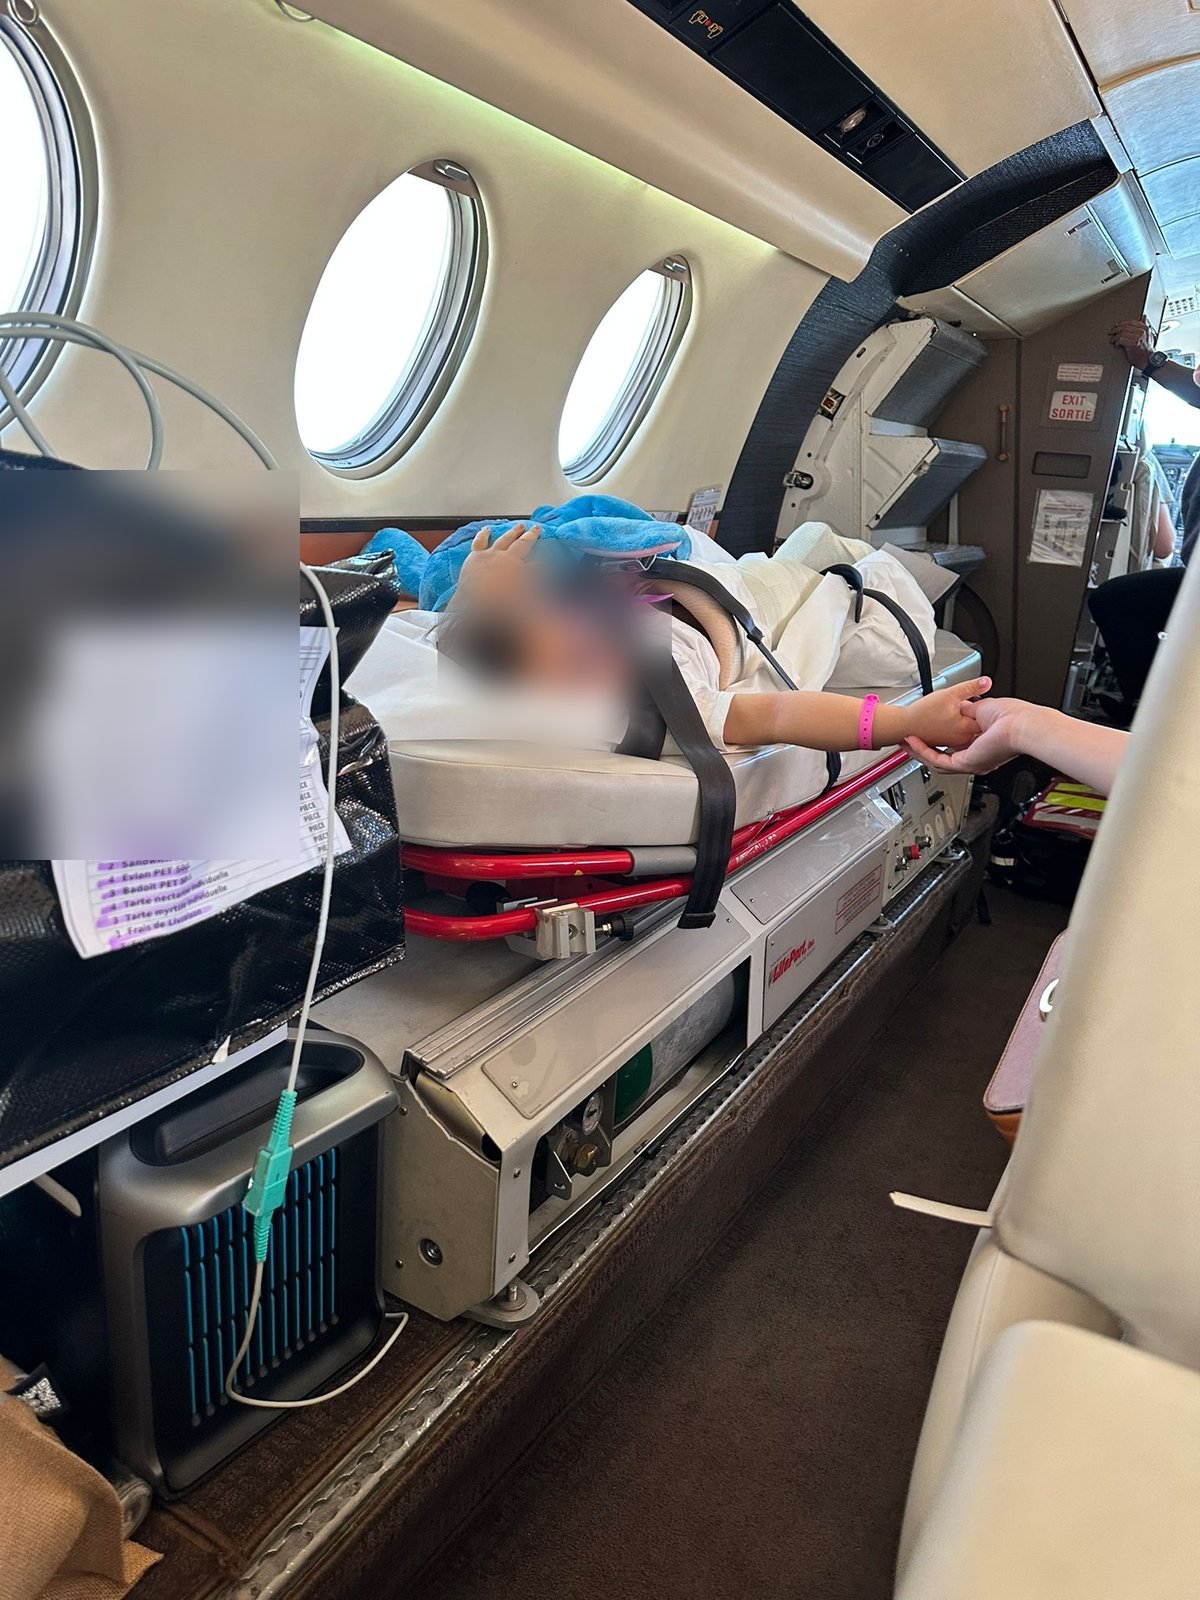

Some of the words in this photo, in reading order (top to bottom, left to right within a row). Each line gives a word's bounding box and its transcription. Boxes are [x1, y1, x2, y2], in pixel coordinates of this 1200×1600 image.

[1062, 394, 1087, 406] EXIT
[1051, 408, 1092, 420] SORTIE
[313, 831, 328, 842] PIEC
[122, 872, 151, 881] Evian
[153, 866, 173, 876] PET
[123, 883, 157, 894] Badoit
[160, 879, 178, 889] PET
[124, 897, 152, 908] Tarte
[126, 911, 153, 921] Tarte
[128, 923, 152, 935] Frais
[153, 919, 166, 929] de
